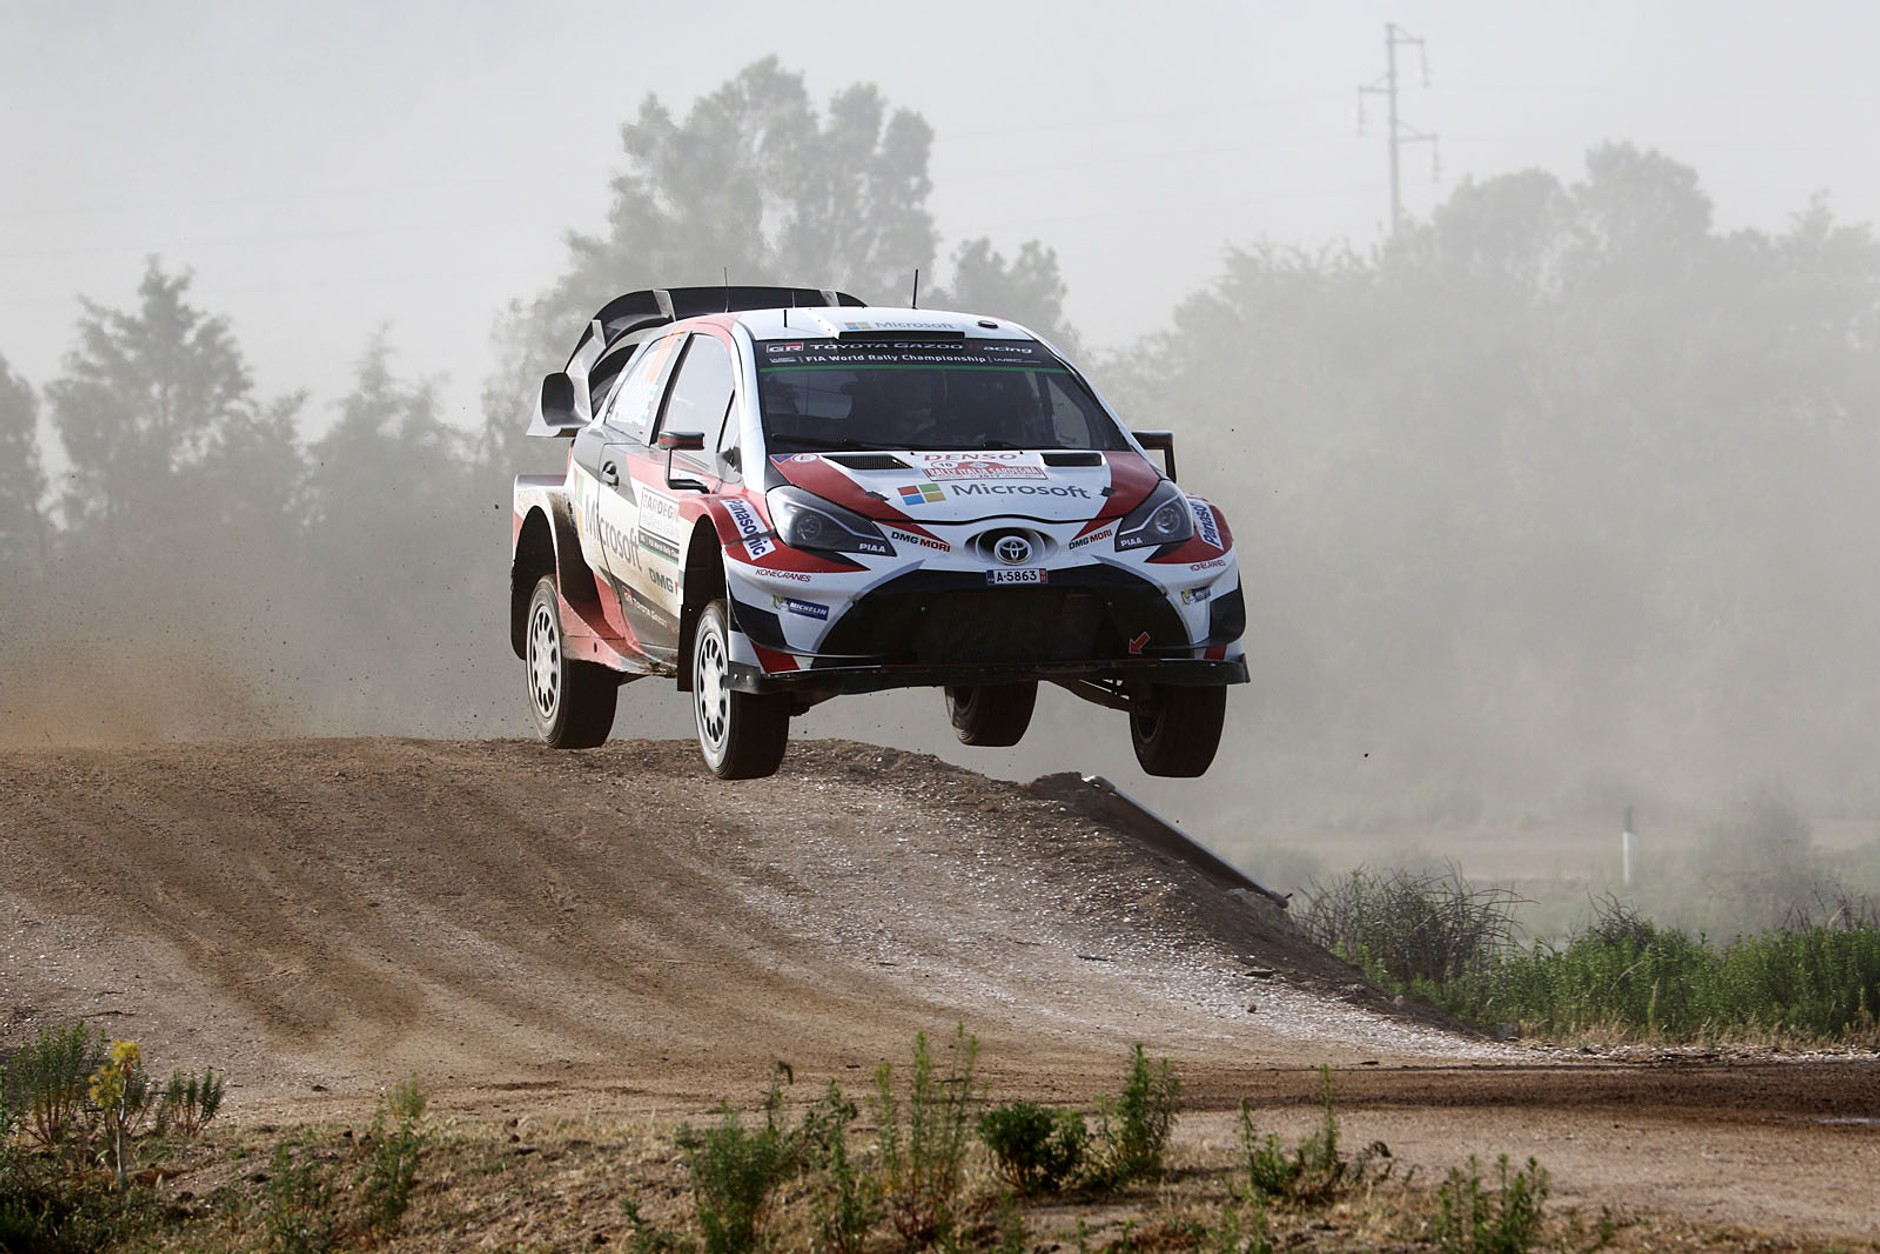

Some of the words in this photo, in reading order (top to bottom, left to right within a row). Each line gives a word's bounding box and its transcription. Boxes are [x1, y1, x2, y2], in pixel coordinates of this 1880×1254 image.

[875, 321, 956, 329] Microsoft
[902, 354, 986, 362] Championship
[924, 453, 1017, 461] DENSO
[951, 483, 1091, 499] Microsoft
[725, 500, 768, 556] Panasonic
[890, 531, 919, 544] DMG
[919, 538, 951, 552] MORI
[1068, 538, 1090, 550] DMG
[1090, 529, 1113, 543] MORI
[1120, 537, 1143, 546] PIAA
[859, 542, 886, 553] PIAA
[648, 567, 675, 594] DMG
[755, 569, 812, 582] KONECRANES
[790, 601, 827, 615] MICHELIN
